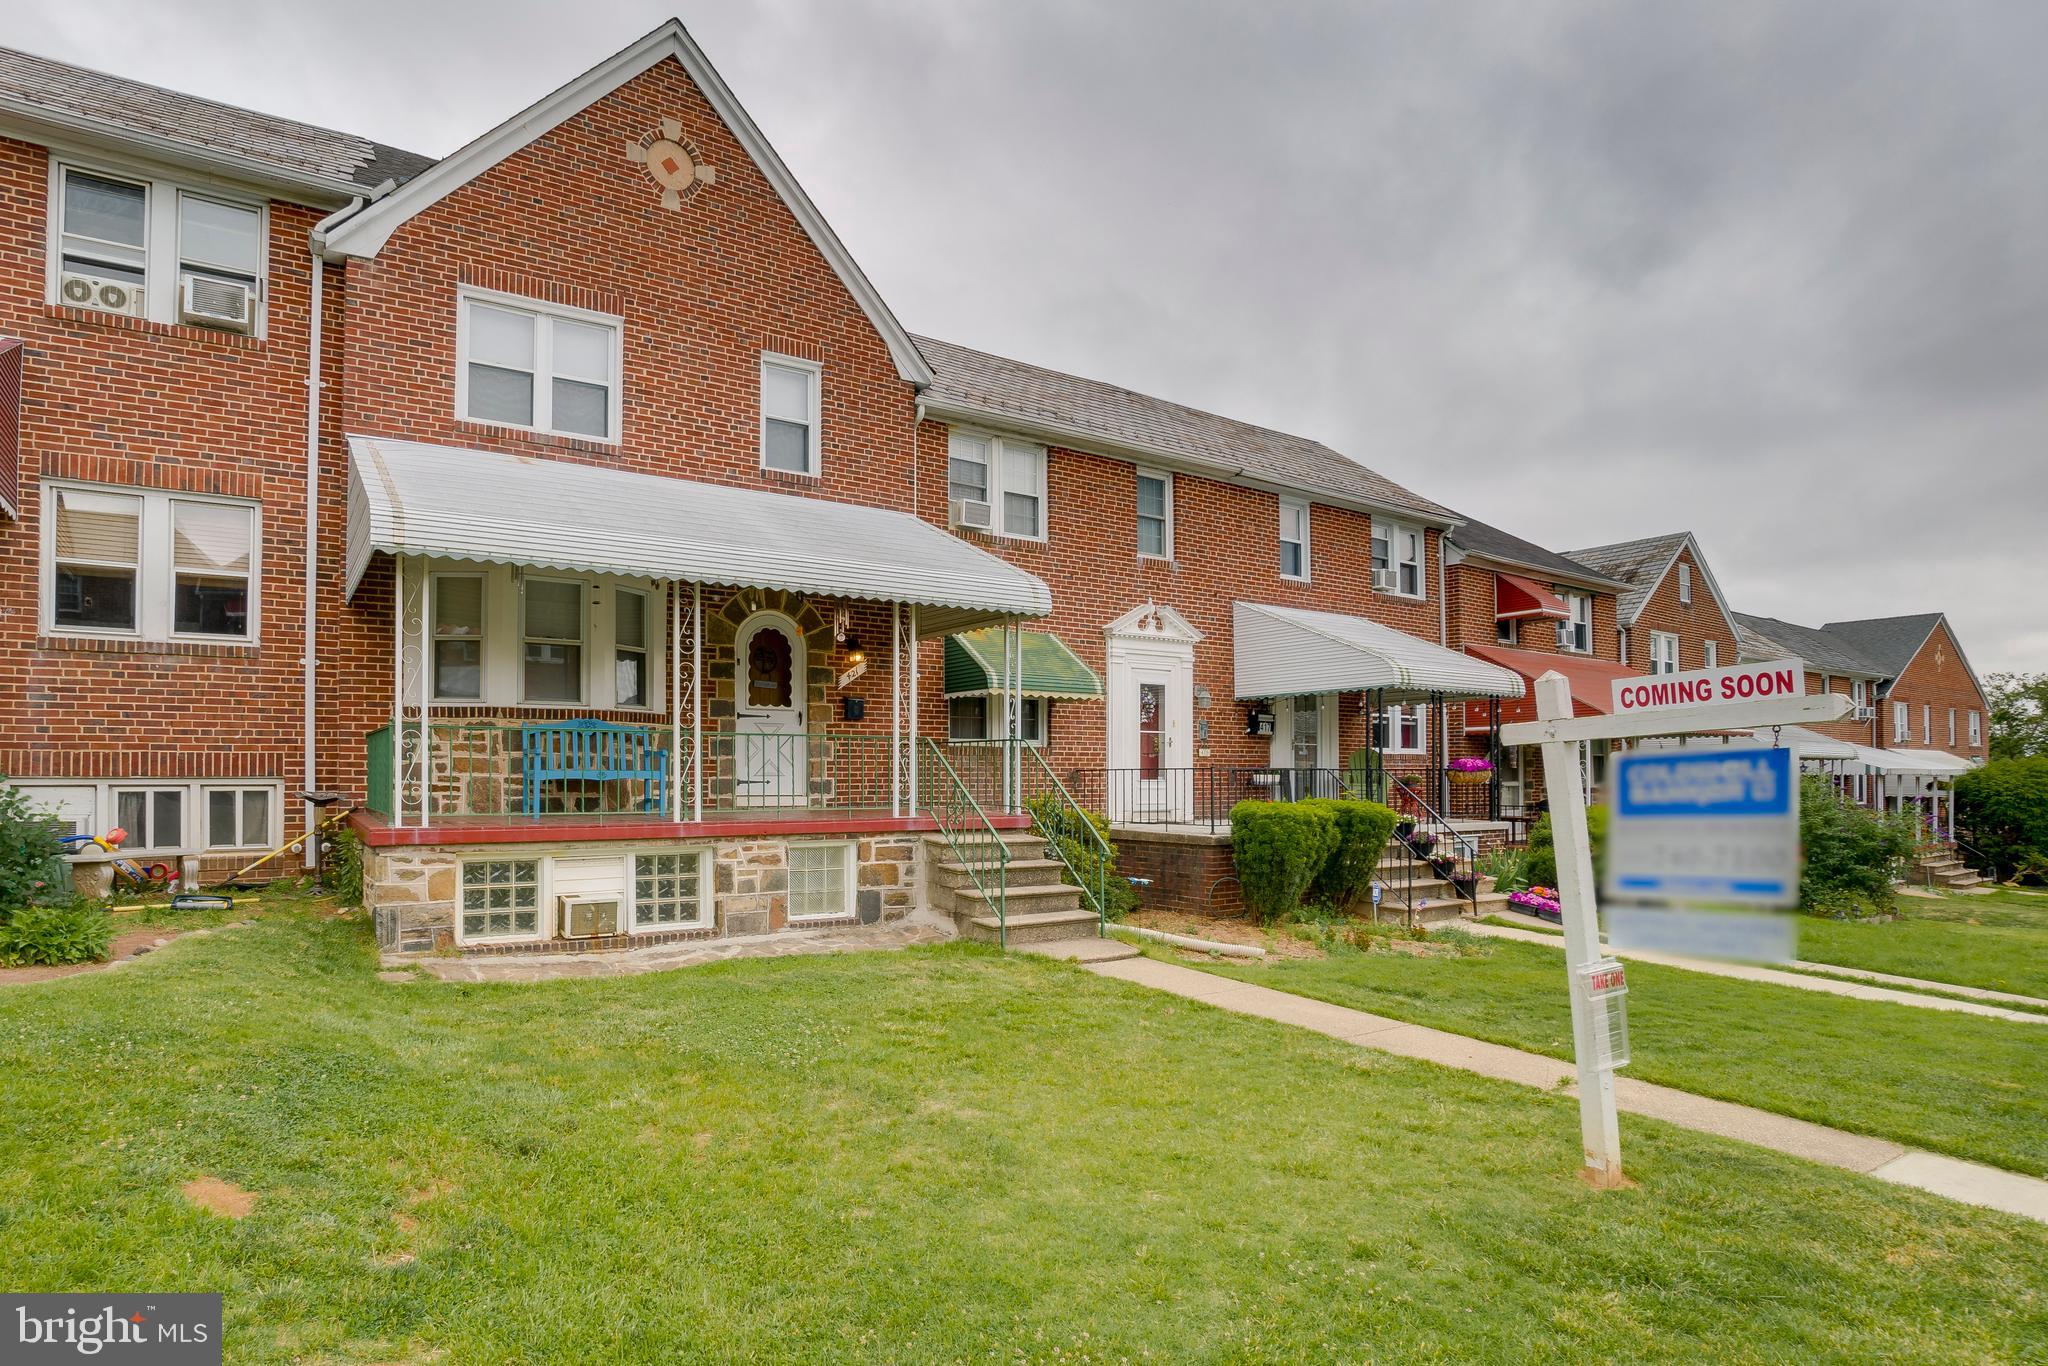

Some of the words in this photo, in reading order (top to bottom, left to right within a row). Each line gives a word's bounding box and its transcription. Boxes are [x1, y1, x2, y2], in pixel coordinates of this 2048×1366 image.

[847, 667, 858, 680] 421
[1621, 679, 1712, 708] COMING
[1720, 670, 1794, 699] SOON
[1592, 974, 1608, 990] TAKE
[1611, 971, 1624, 986] ONE
